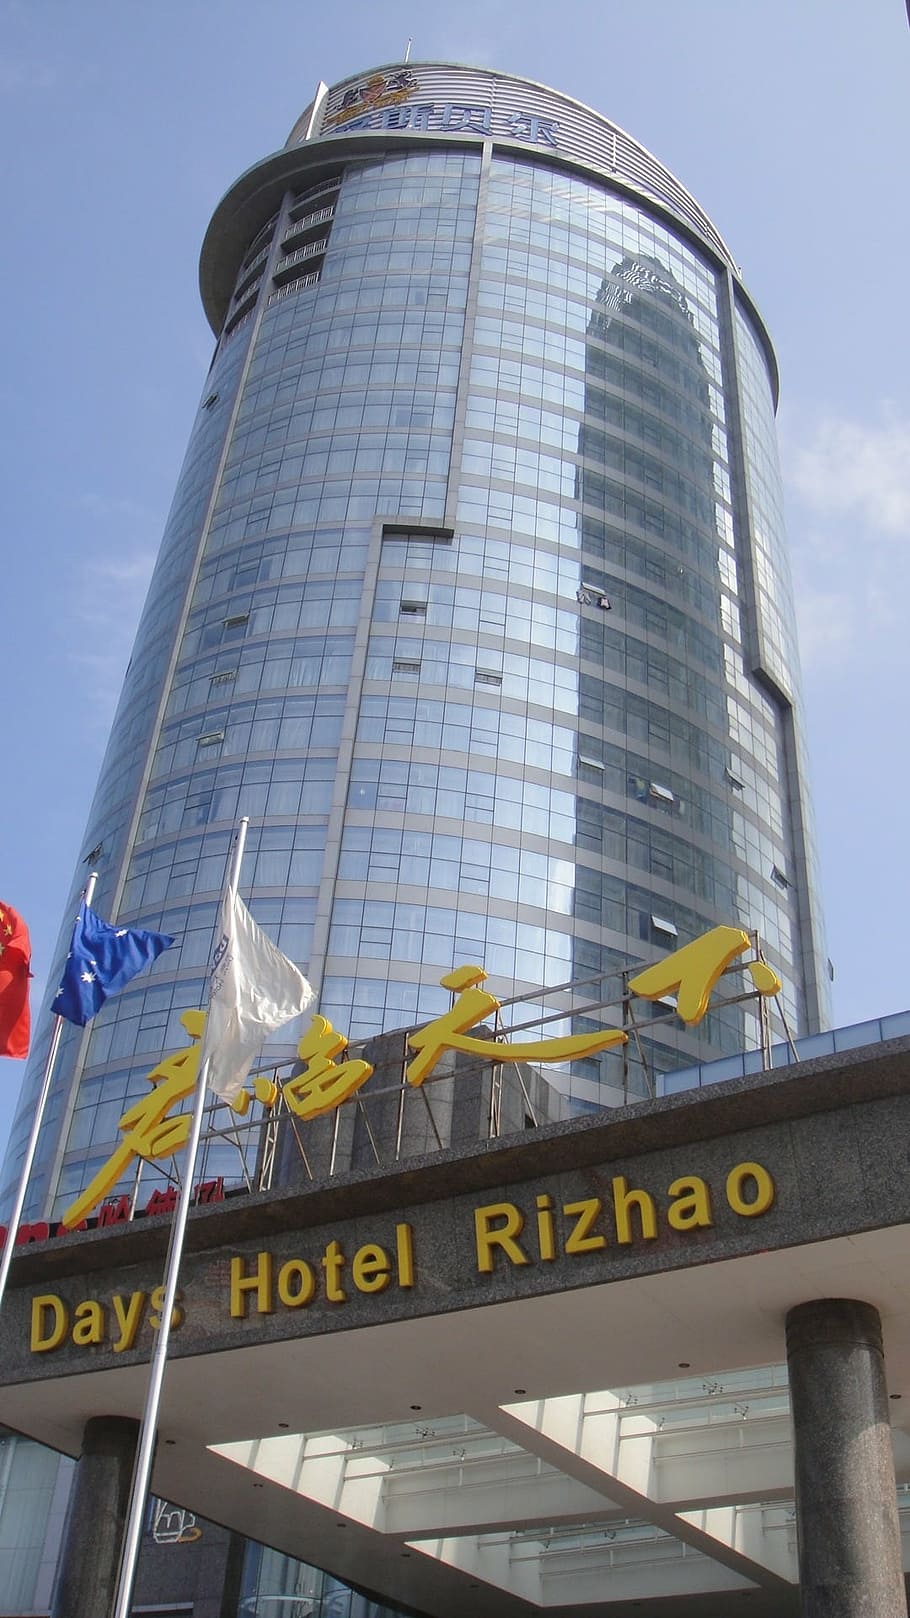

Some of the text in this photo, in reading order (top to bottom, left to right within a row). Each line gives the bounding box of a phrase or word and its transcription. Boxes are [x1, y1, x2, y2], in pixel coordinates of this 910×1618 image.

[30, 1162, 776, 1353] Days Hotel Rizhao
